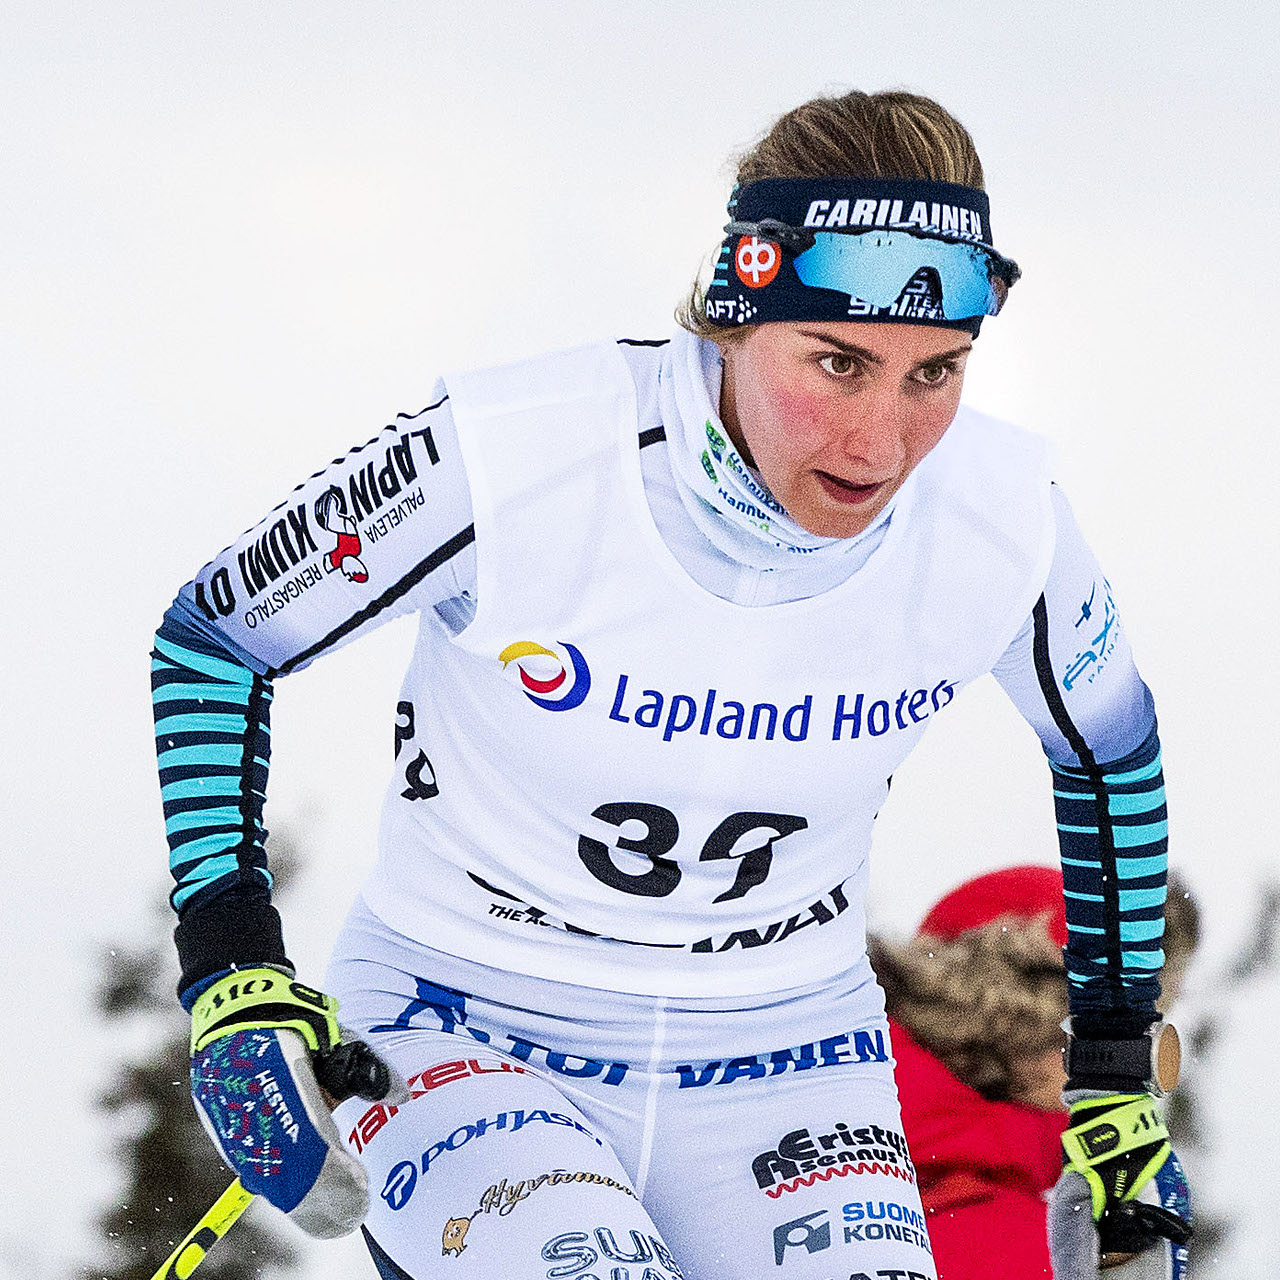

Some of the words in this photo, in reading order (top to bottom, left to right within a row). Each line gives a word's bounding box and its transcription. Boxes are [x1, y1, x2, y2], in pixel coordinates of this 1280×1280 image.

[803, 199, 982, 235] CARILAINEN
[348, 426, 441, 522] LAPIN
[365, 487, 425, 545] PALVELEVA
[238, 503, 320, 598] KUMI
[246, 563, 322, 630] RENGASTALO
[609, 674, 813, 742] Lapland
[578, 802, 808, 904] 39
[488, 903, 525, 922] THE
[255, 1069, 300, 1144] HESTRA
